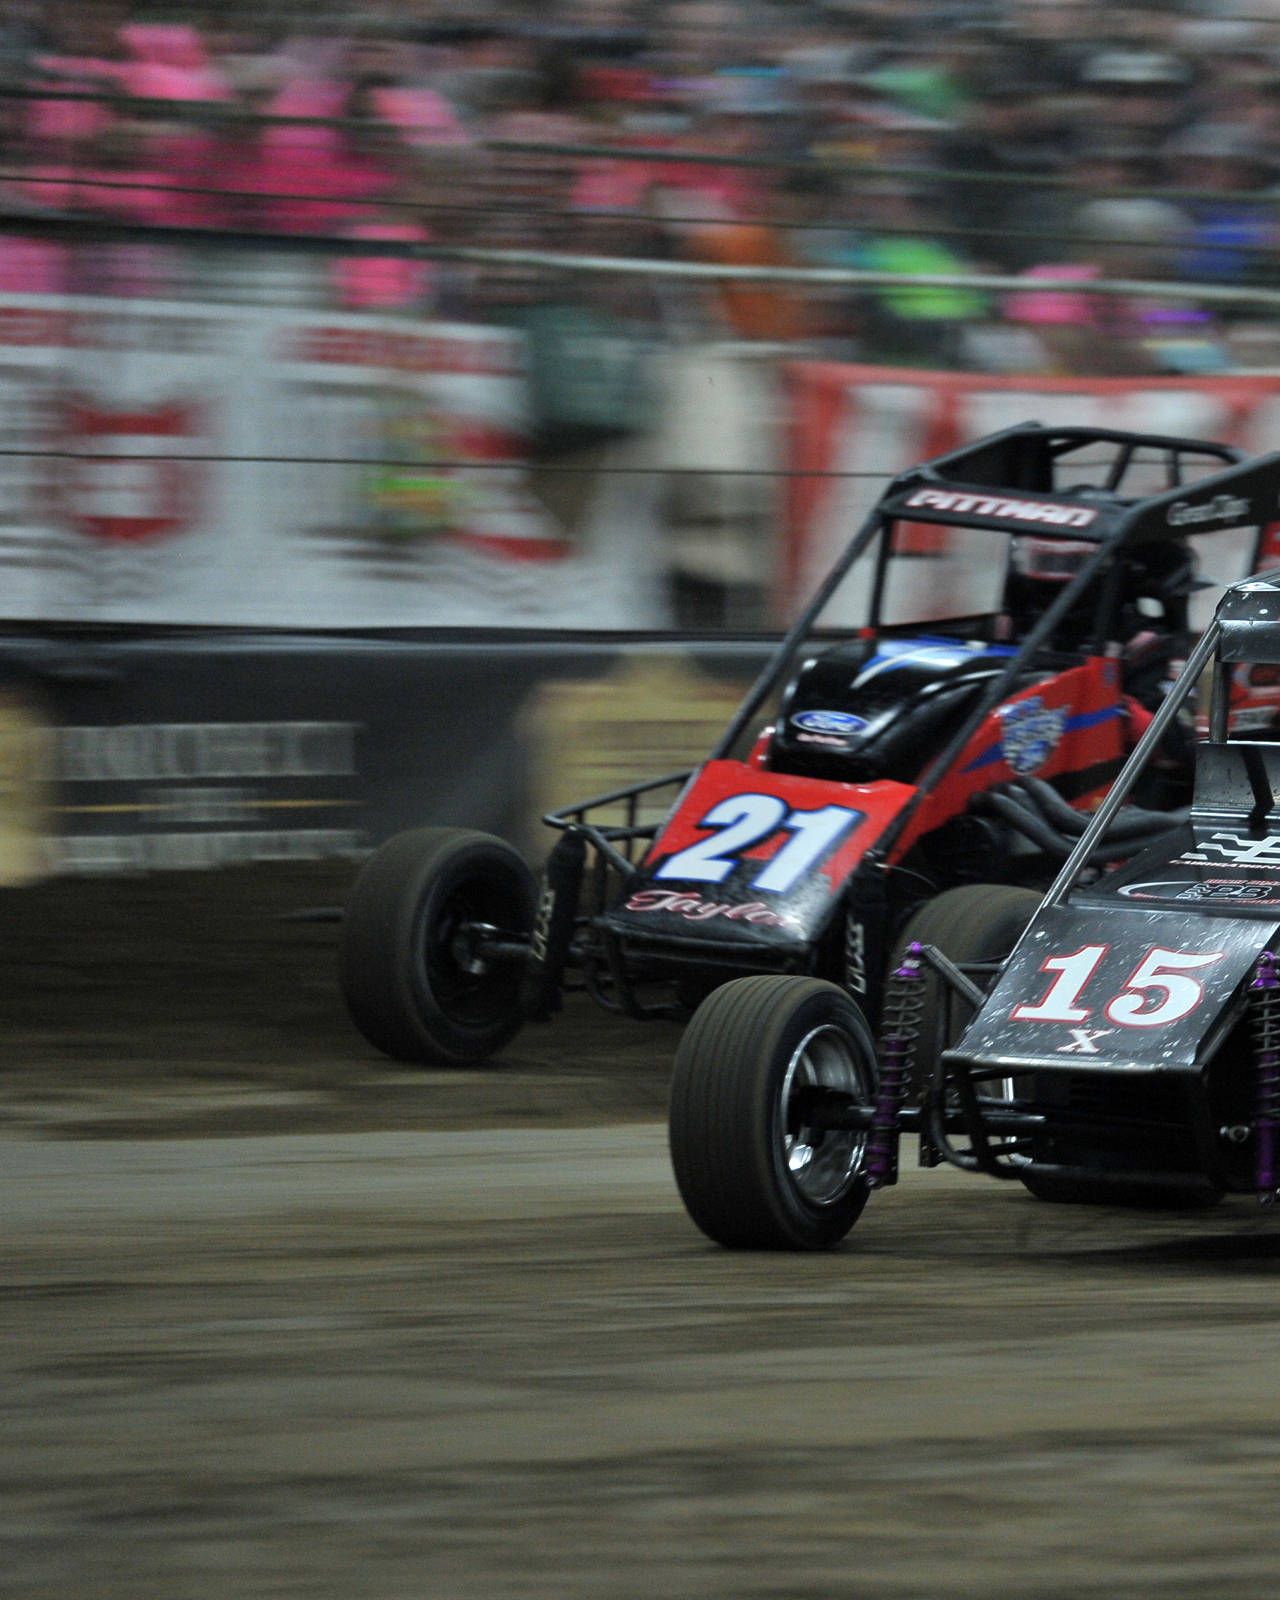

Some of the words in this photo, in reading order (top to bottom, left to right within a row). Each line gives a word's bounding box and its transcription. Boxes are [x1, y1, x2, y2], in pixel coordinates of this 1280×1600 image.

[905, 489, 1098, 527] PITTMAN
[653, 792, 866, 895] 21
[1008, 944, 1225, 1029] 15
[1055, 1028, 1114, 1053] X
